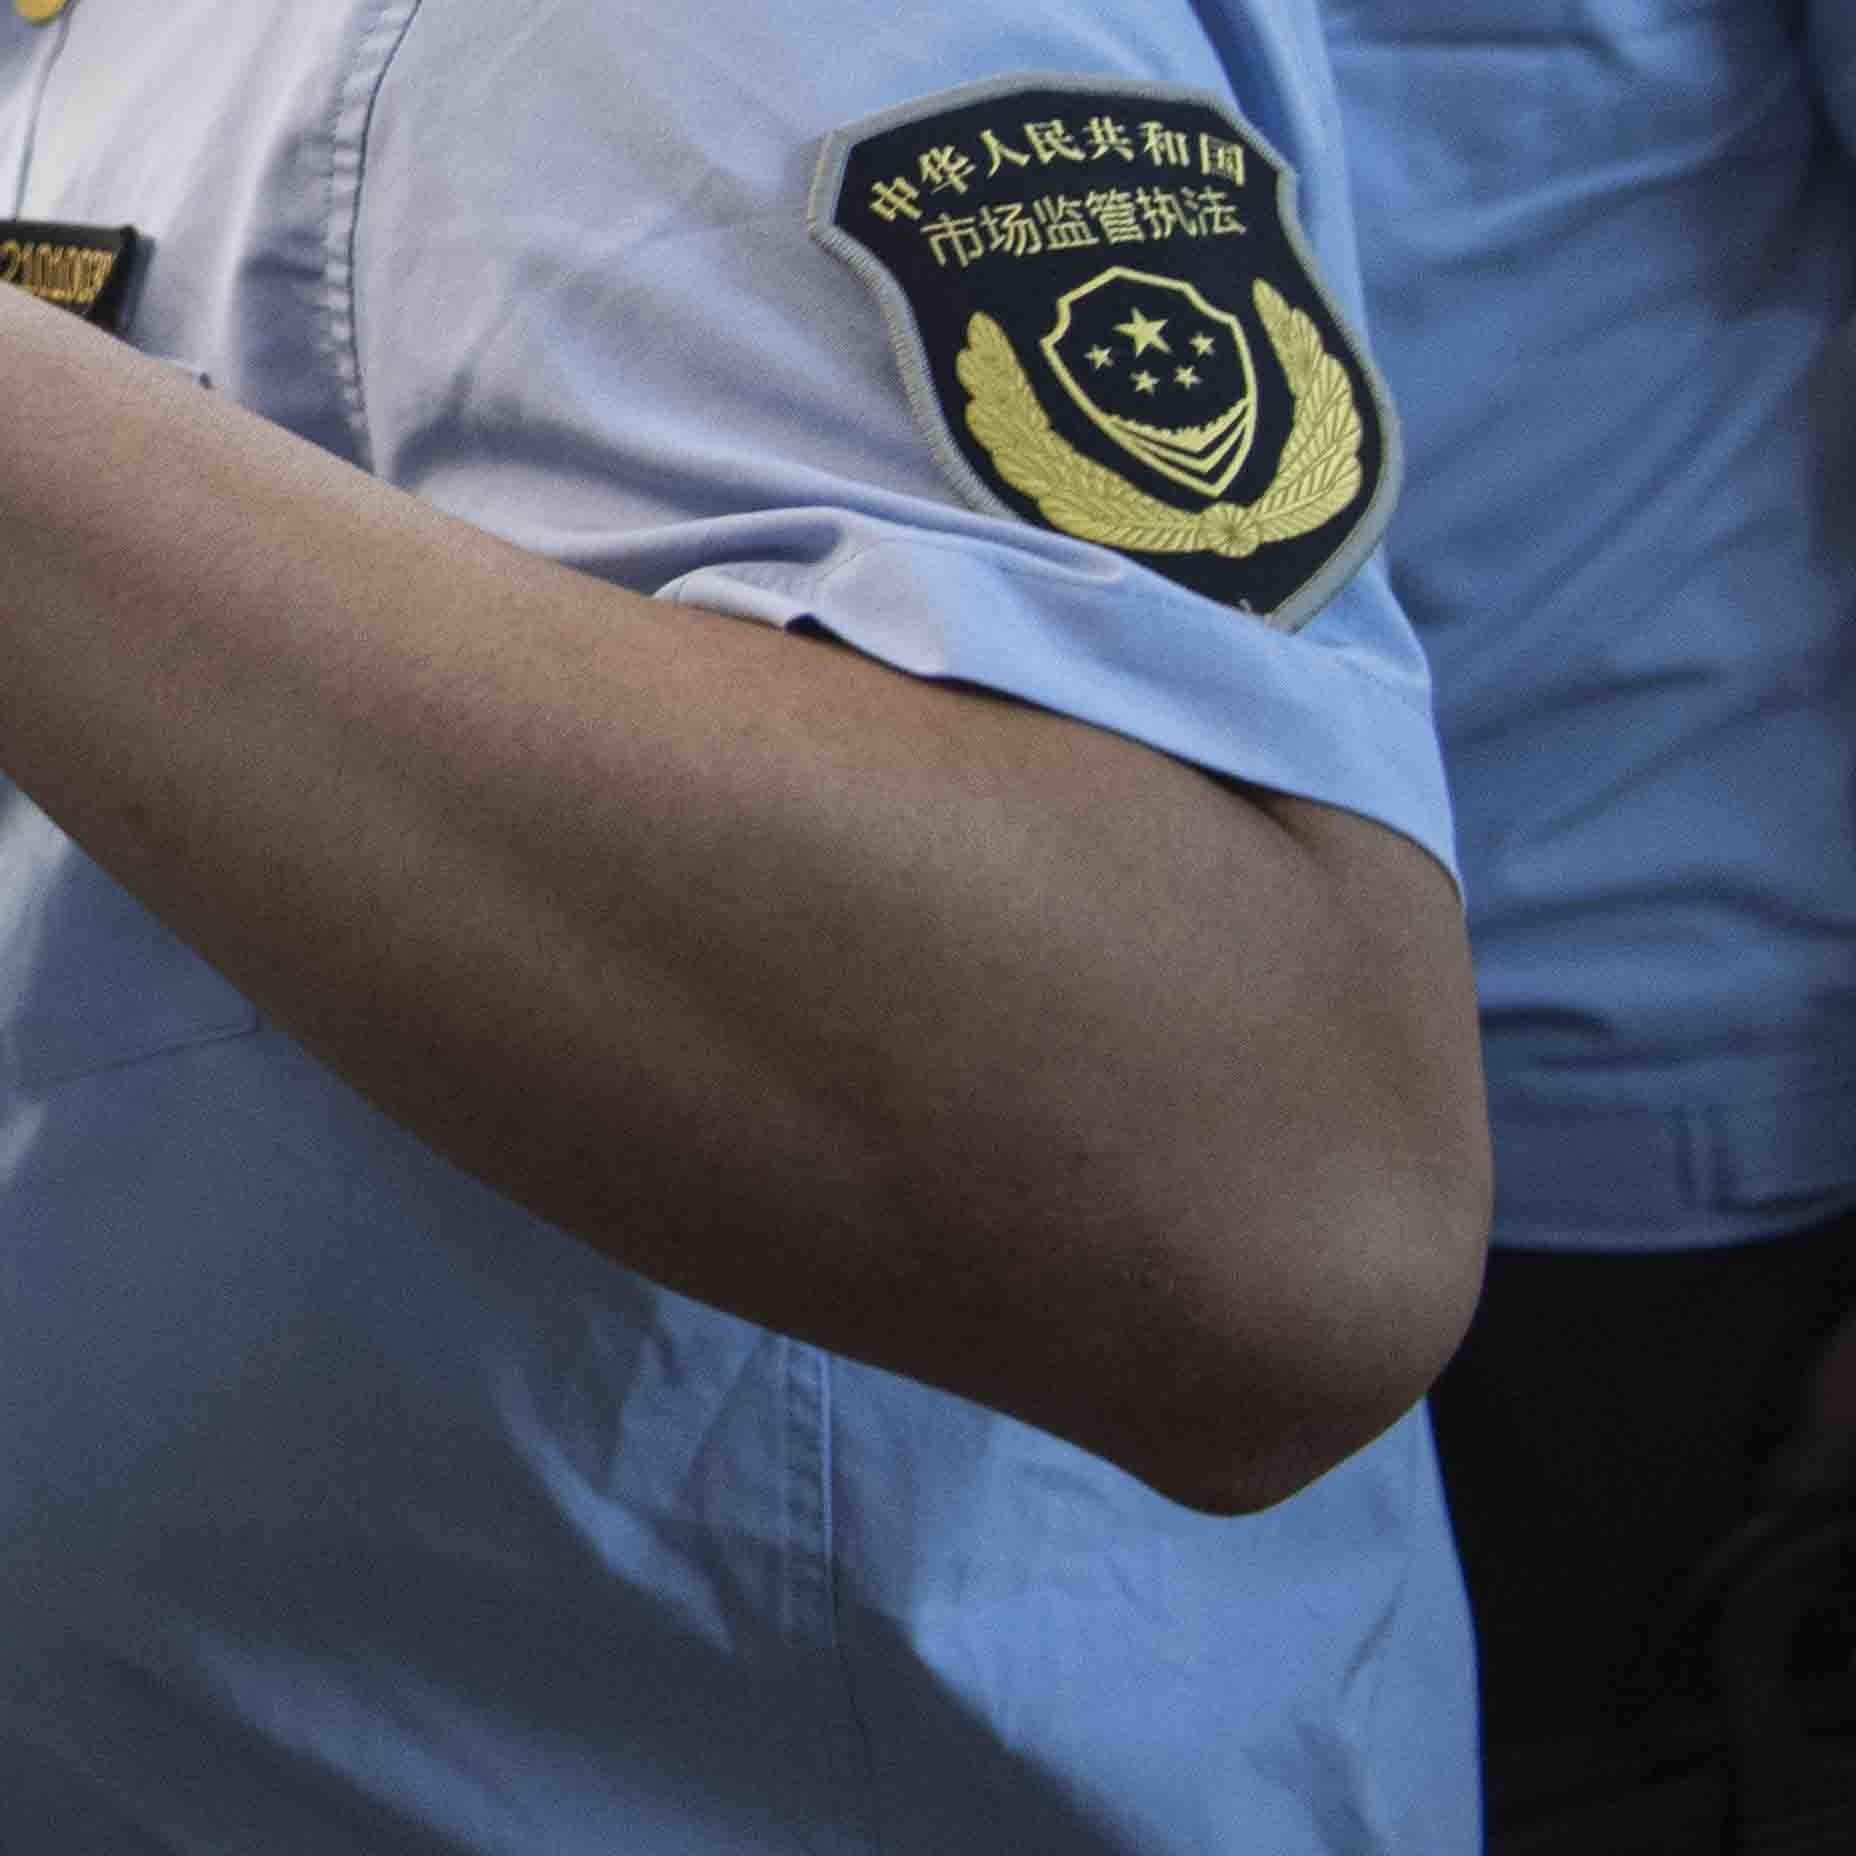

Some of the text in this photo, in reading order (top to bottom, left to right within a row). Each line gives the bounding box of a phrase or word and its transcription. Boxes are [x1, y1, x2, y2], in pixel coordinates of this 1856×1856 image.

[868, 115, 1246, 225] 中华人民共和国
[920, 184, 1246, 268] 市场监管执法
